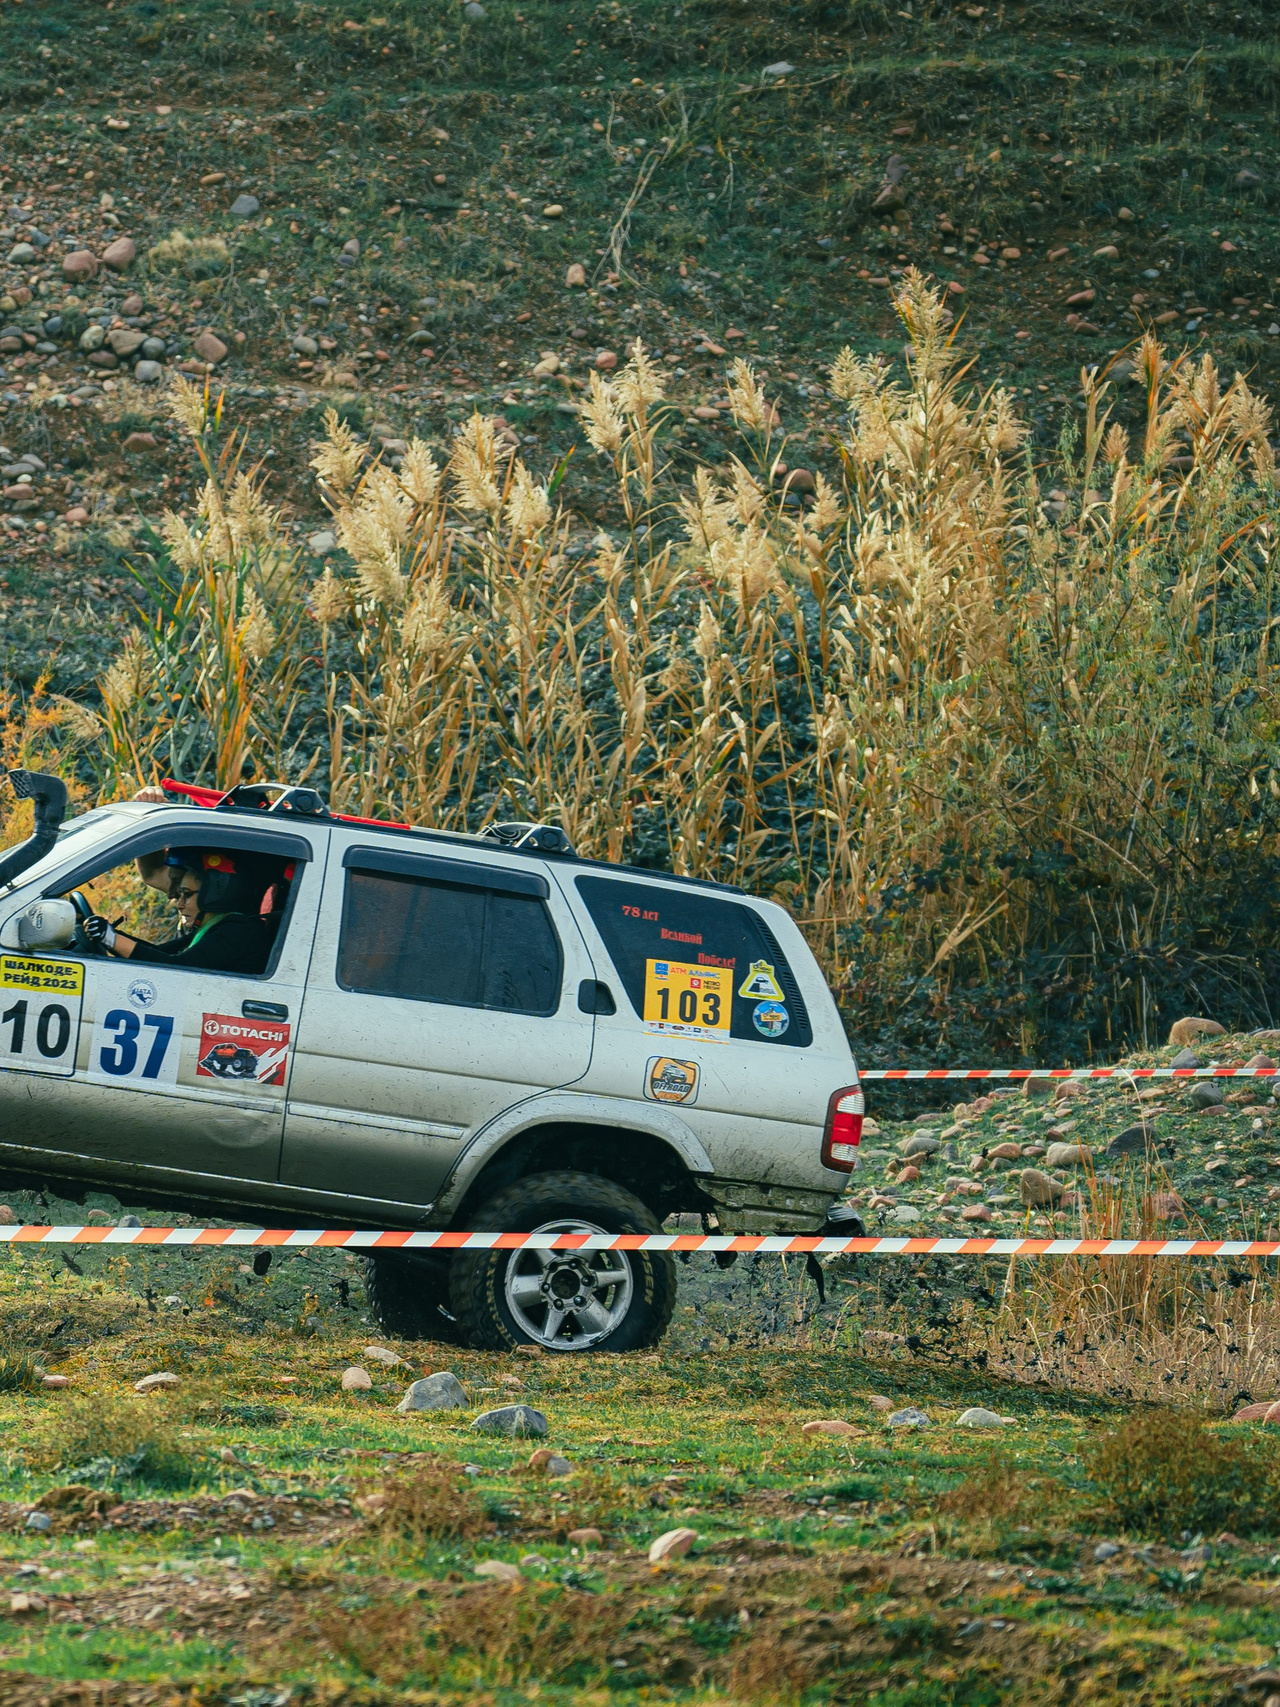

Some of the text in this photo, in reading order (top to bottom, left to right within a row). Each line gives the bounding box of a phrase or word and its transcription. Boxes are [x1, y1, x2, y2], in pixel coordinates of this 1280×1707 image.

[622, 905, 640, 918] 78
[4, 960, 78, 976] ШАЛКОДЕ-
[4, 973, 78, 989] РЕЙД 2023
[657, 987, 721, 1026] 103
[1, 1000, 71, 1059] 10
[221, 1024, 283, 1042] TOTACHI
[99, 1009, 174, 1079] 37
[653, 1081, 691, 1093] OFFROAD
